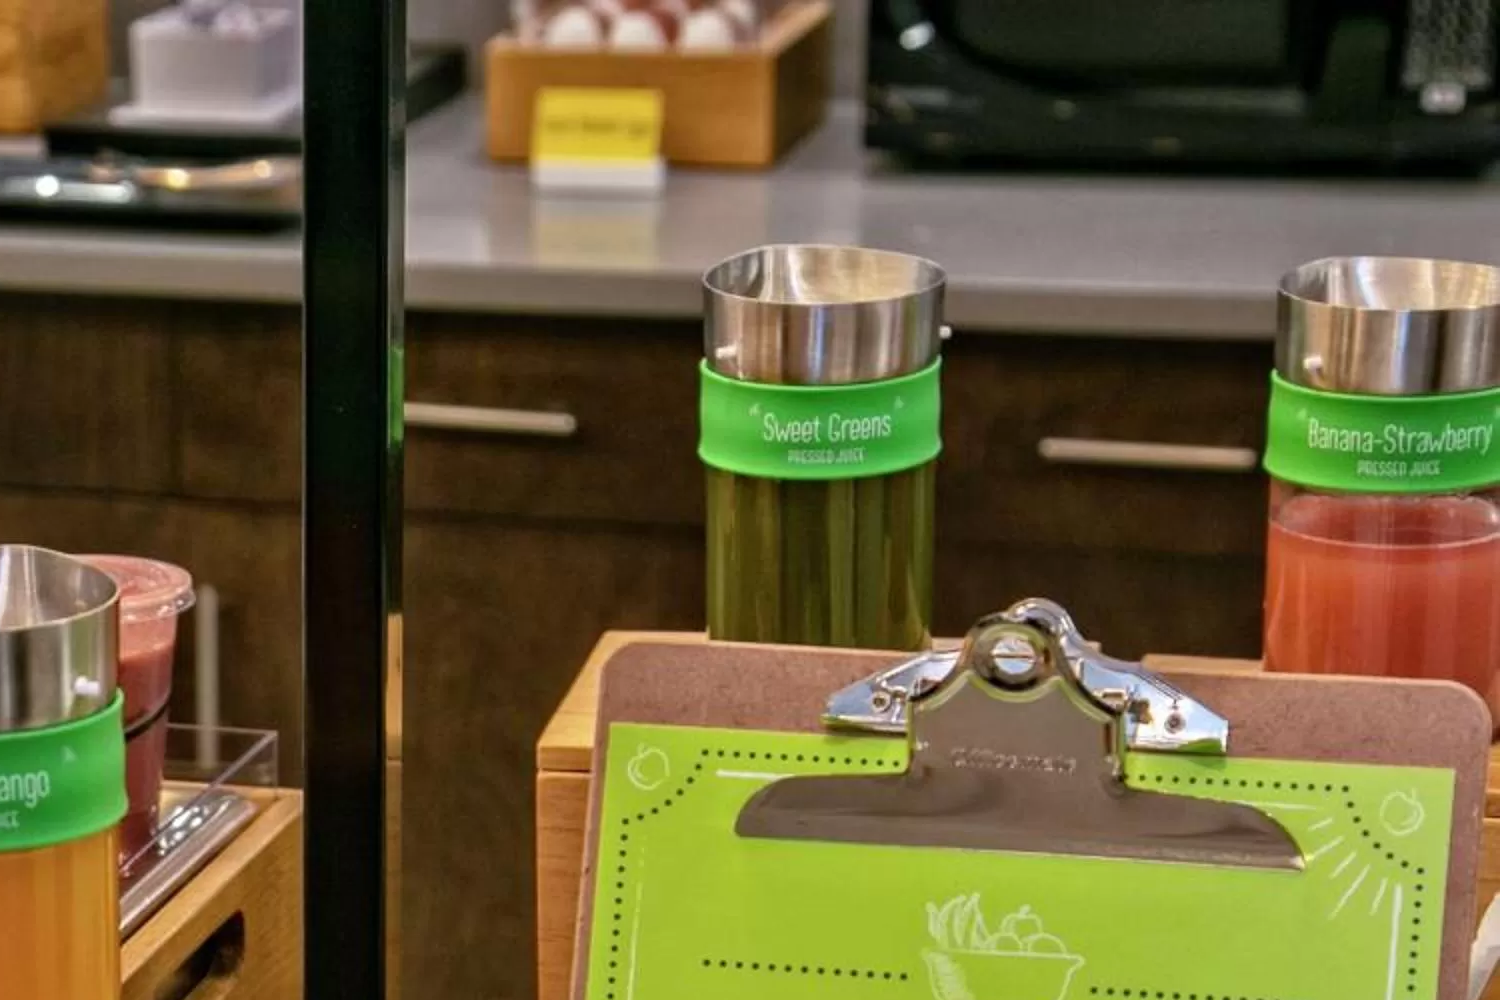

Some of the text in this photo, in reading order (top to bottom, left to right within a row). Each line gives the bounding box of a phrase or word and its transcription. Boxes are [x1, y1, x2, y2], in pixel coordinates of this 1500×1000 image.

[763, 412, 892, 442] Sweet Greens
[1307, 416, 1493, 456] Banana-Strawberry
